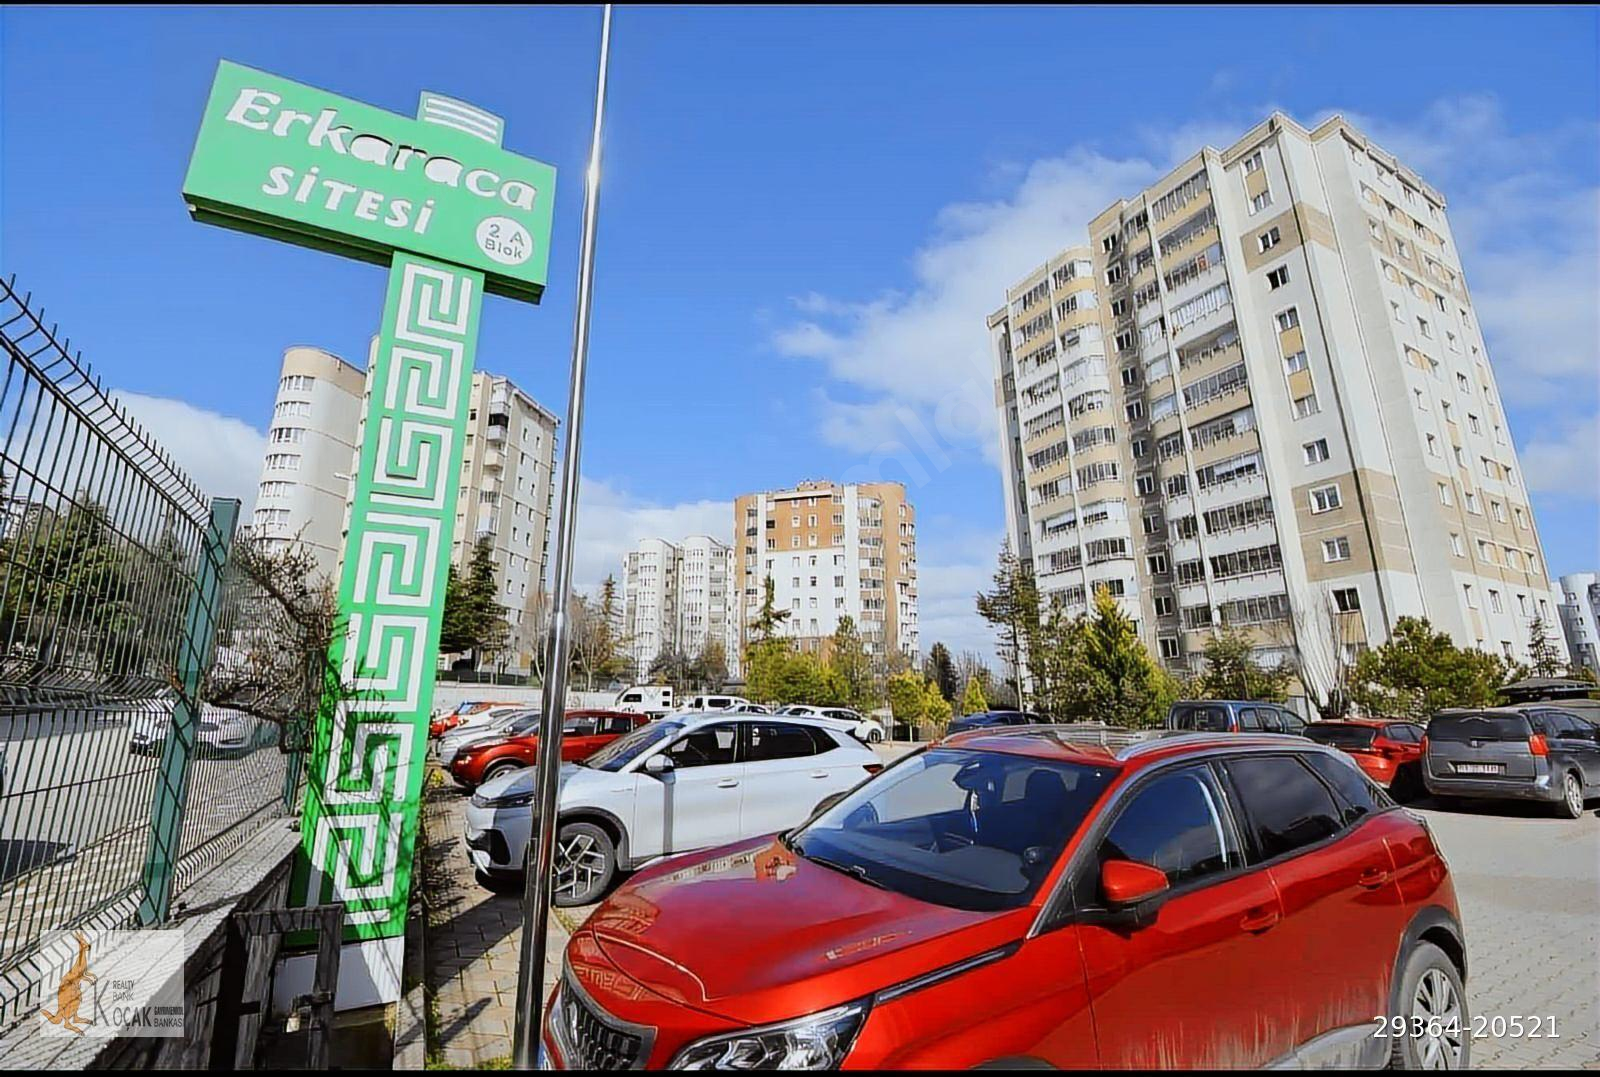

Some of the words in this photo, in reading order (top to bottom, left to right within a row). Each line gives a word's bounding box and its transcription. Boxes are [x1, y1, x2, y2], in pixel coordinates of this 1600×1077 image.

[225, 88, 536, 211] Erkaraca
[489, 224, 500, 238] 2
[510, 231, 524, 246] A
[485, 238, 523, 259] Blok
